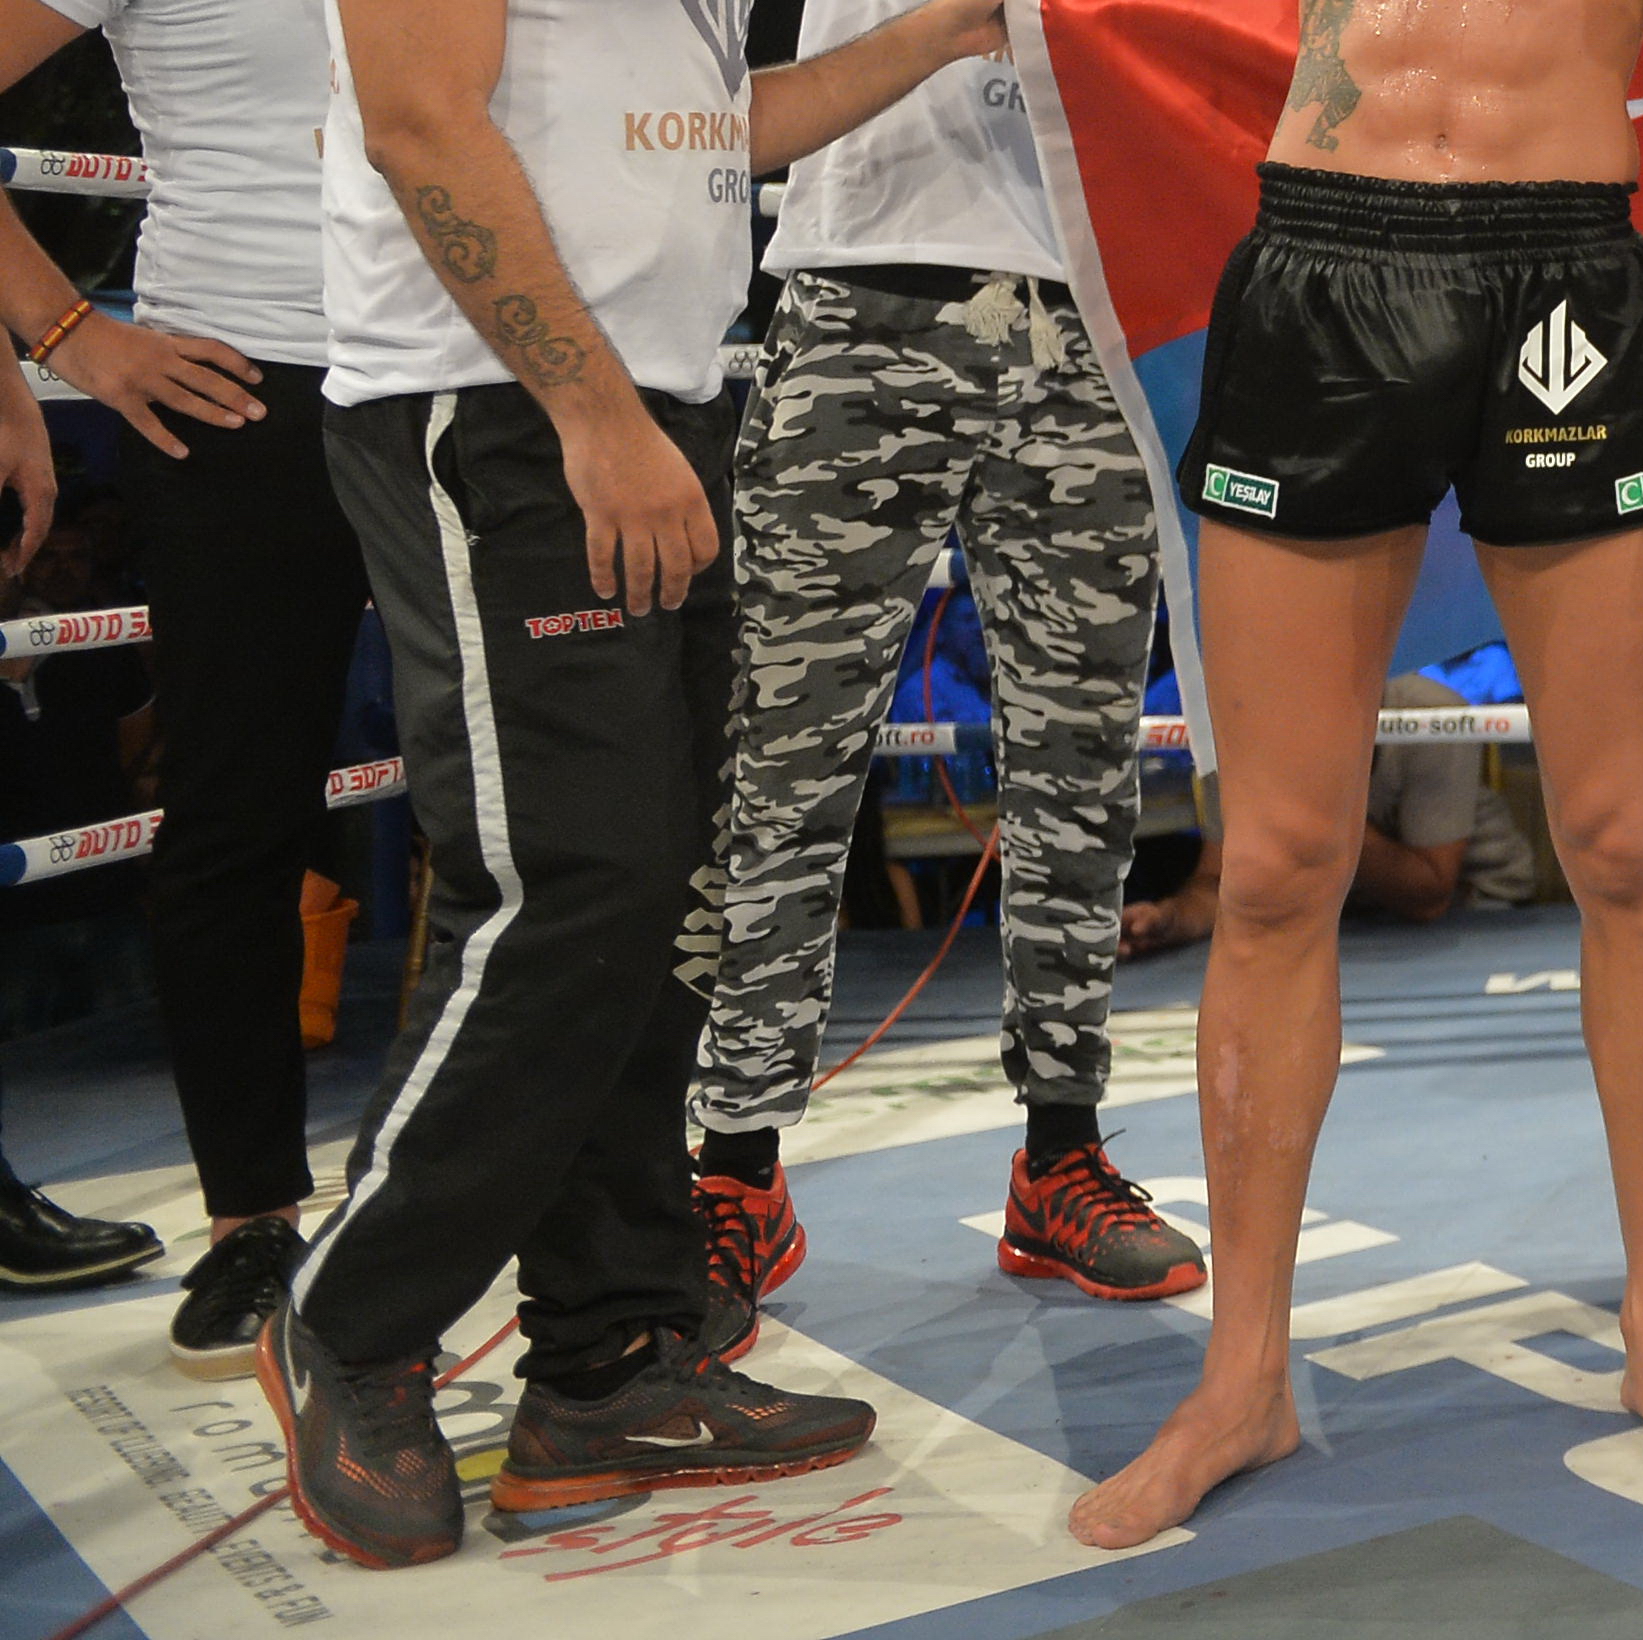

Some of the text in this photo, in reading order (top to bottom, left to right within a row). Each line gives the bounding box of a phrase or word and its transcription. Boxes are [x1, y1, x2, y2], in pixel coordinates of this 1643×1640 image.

[66, 154, 133, 182] AUTO
[708, 166, 750, 203] GRO
[1505, 424, 1607, 447] KORKMAZLAR
[1525, 453, 1576, 469] GROUP
[56, 612, 123, 645] AUTO
[525, 609, 624, 639] TOP TEN
[1379, 714, 1511, 735] uto-soft.ro
[75, 819, 142, 860] AUTO
